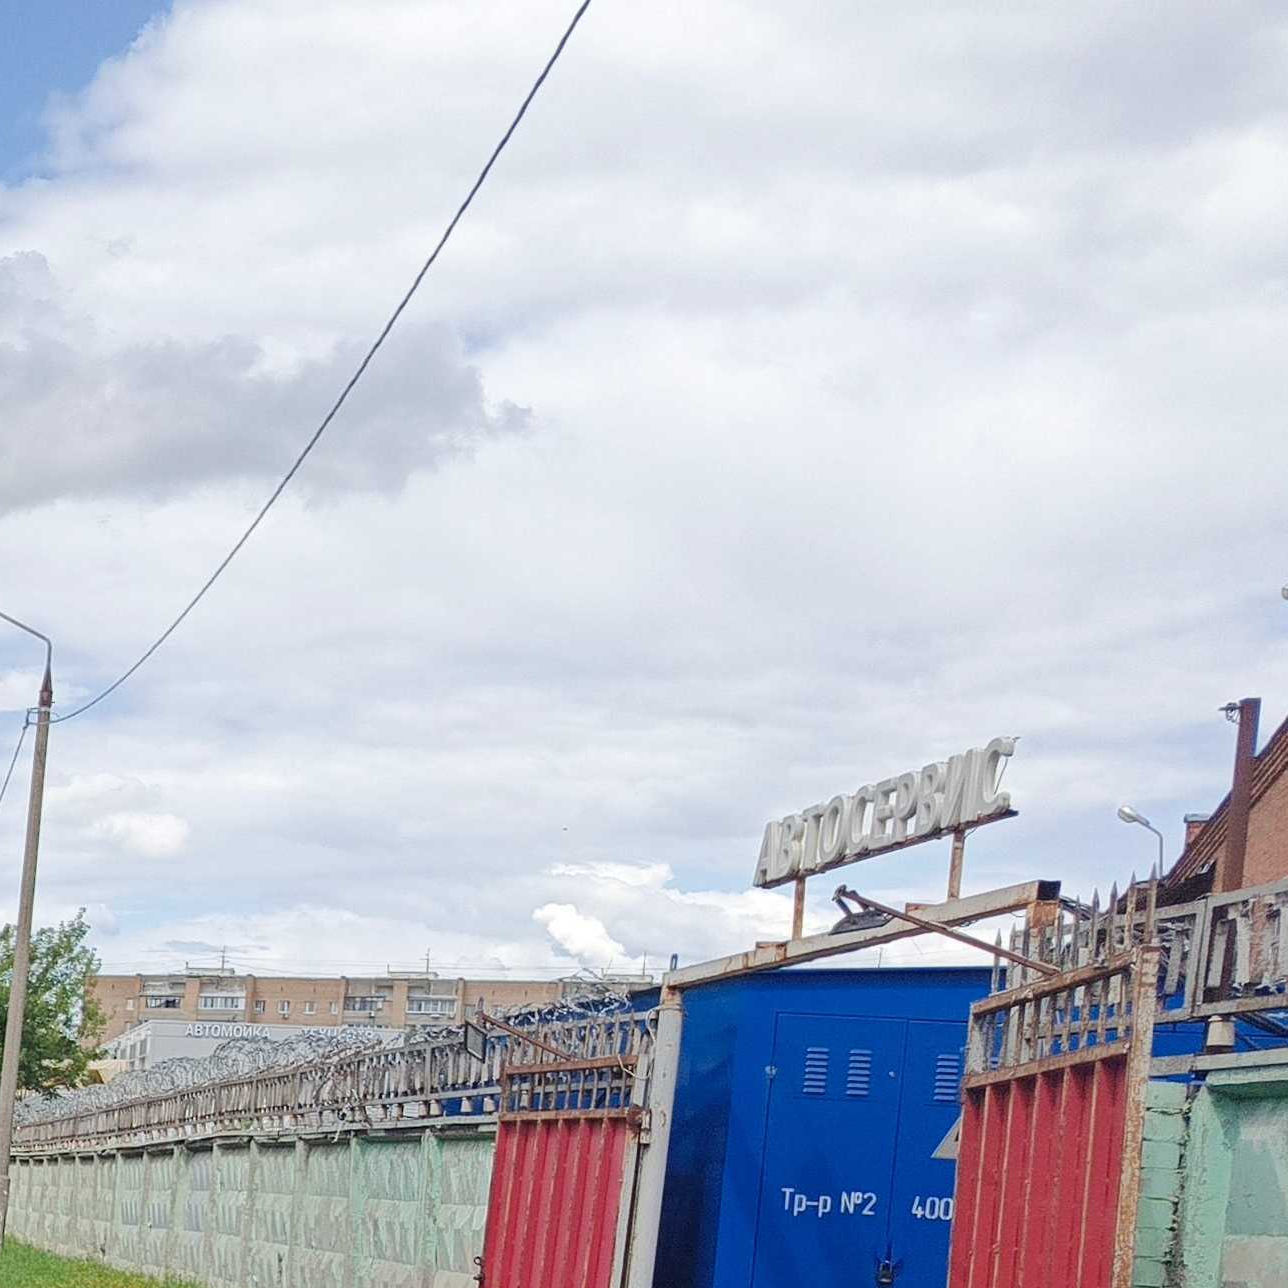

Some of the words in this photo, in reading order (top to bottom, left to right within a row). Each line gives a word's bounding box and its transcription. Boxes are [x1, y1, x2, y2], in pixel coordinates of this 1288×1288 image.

[753, 736, 1018, 888] АВТОСЕРВИС
[780, 1186, 832, 1218] Тр-р
[840, 1191, 877, 1216] №2
[911, 1195, 954, 1220] 400
